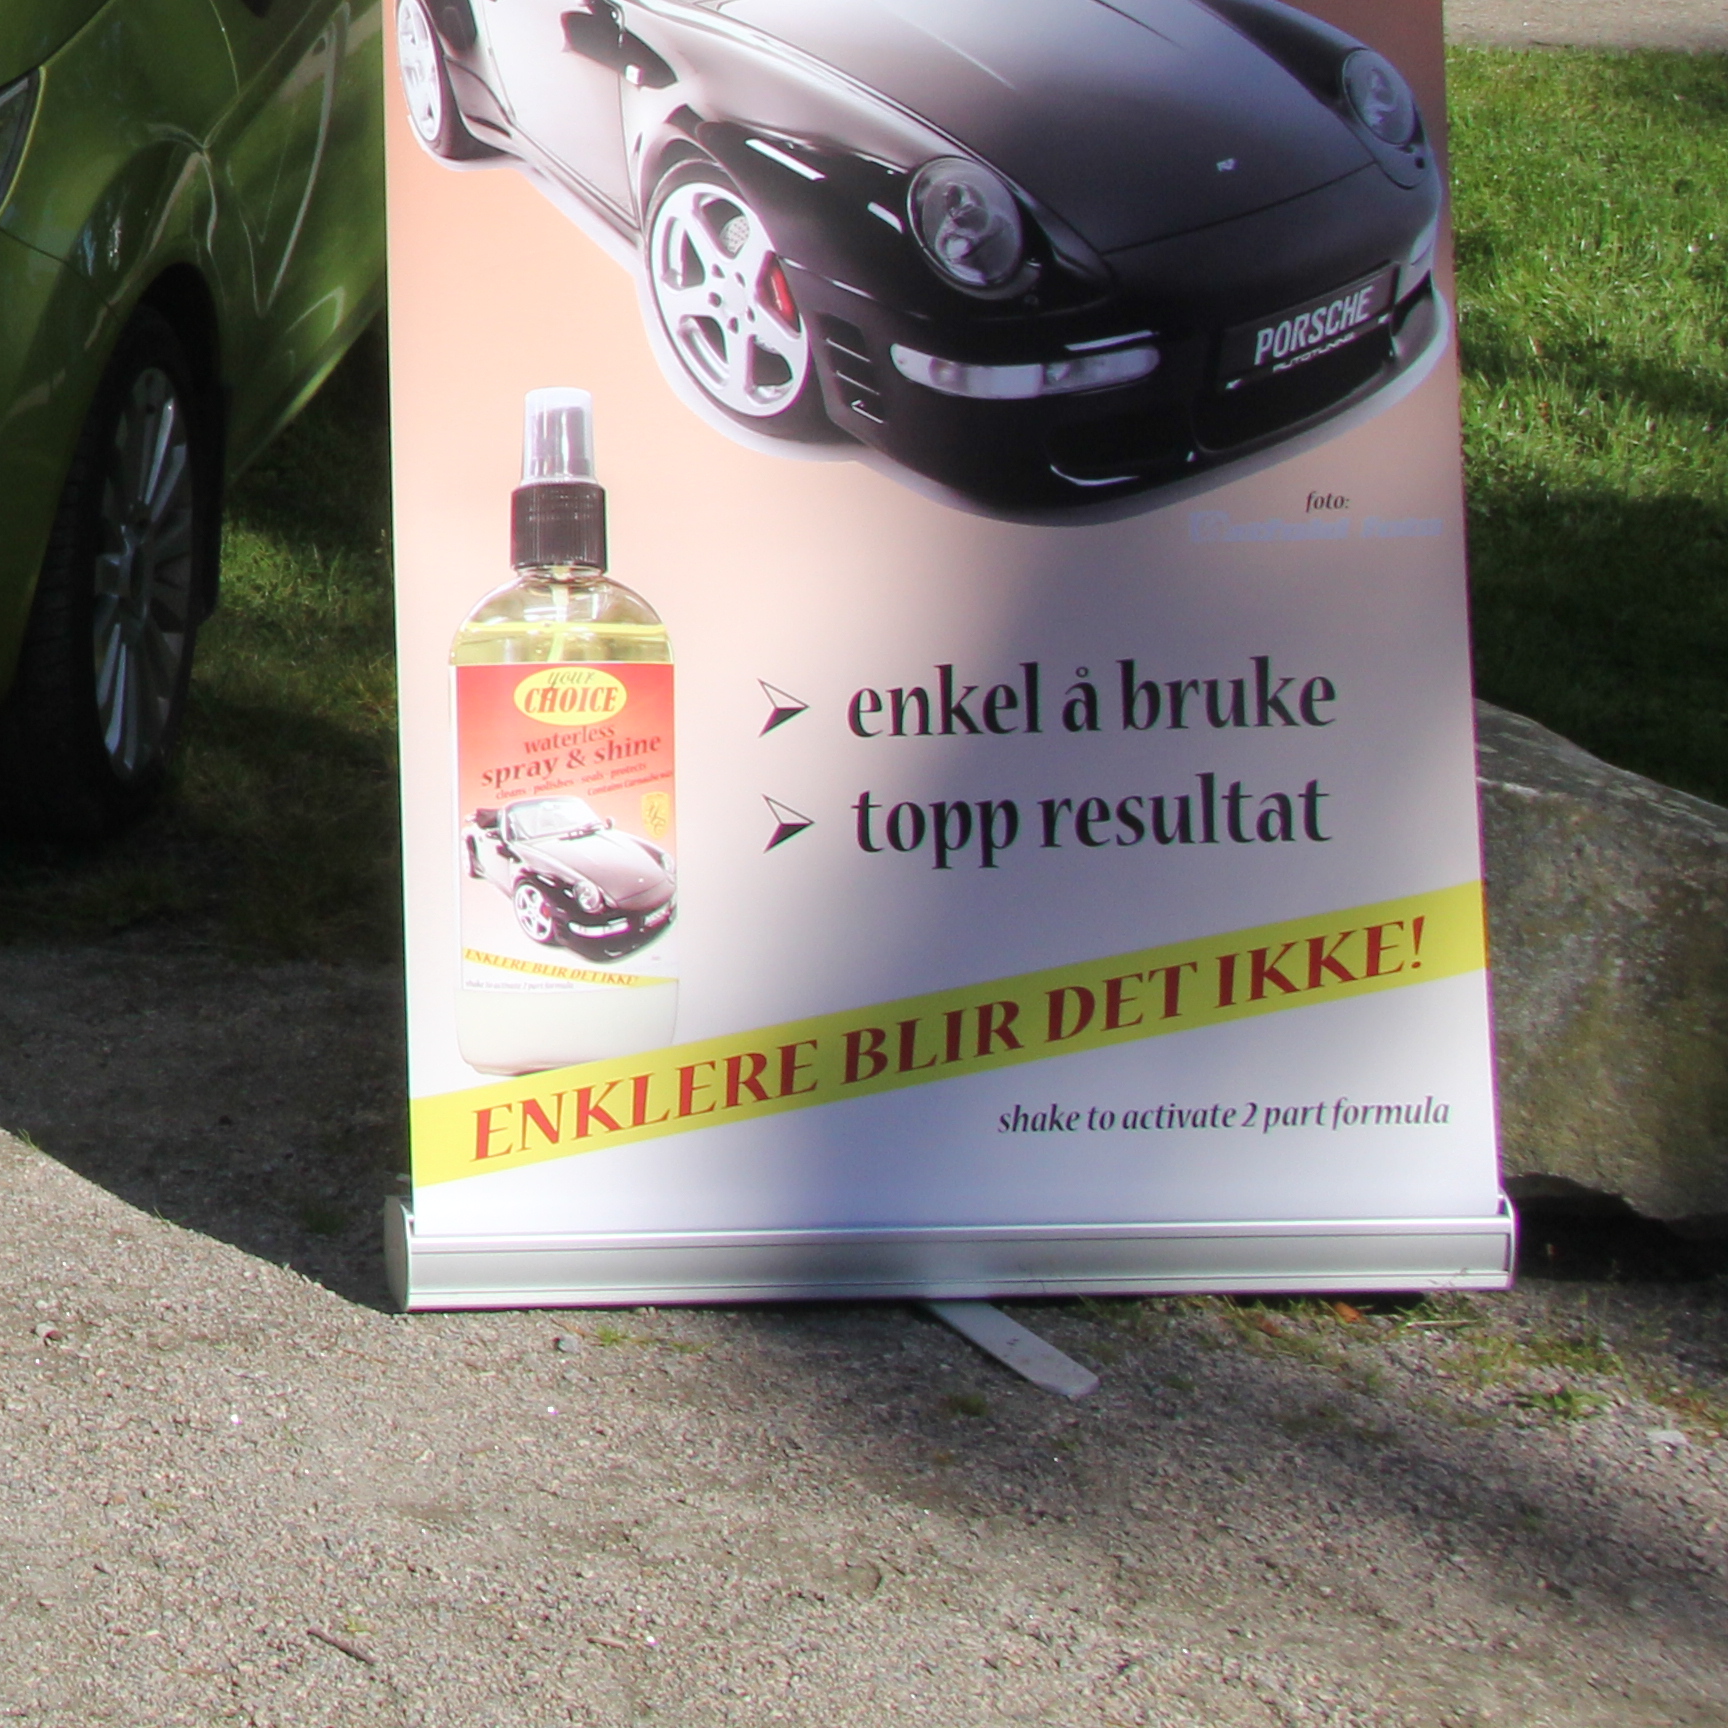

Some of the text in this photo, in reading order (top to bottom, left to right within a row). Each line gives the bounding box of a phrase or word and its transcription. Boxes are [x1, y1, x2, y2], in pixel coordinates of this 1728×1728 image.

[1254, 285, 1375, 366] PORSCHE
[1305, 490, 1350, 513] foto:
[524, 686, 619, 714] CHOICE
[547, 670, 595, 696] your
[846, 655, 1338, 741] enkel å bruke
[523, 724, 616, 754] waterless
[480, 735, 662, 789] spray & shine
[850, 772, 1332, 868] topp resultat
[465, 948, 530, 970] ENKLERE
[532, 962, 567, 978] BLIR
[468, 914, 1428, 1164] ENKLERE BLIR DET IKKE!
[997, 1097, 1451, 1135] shake to activate 2 part formula
